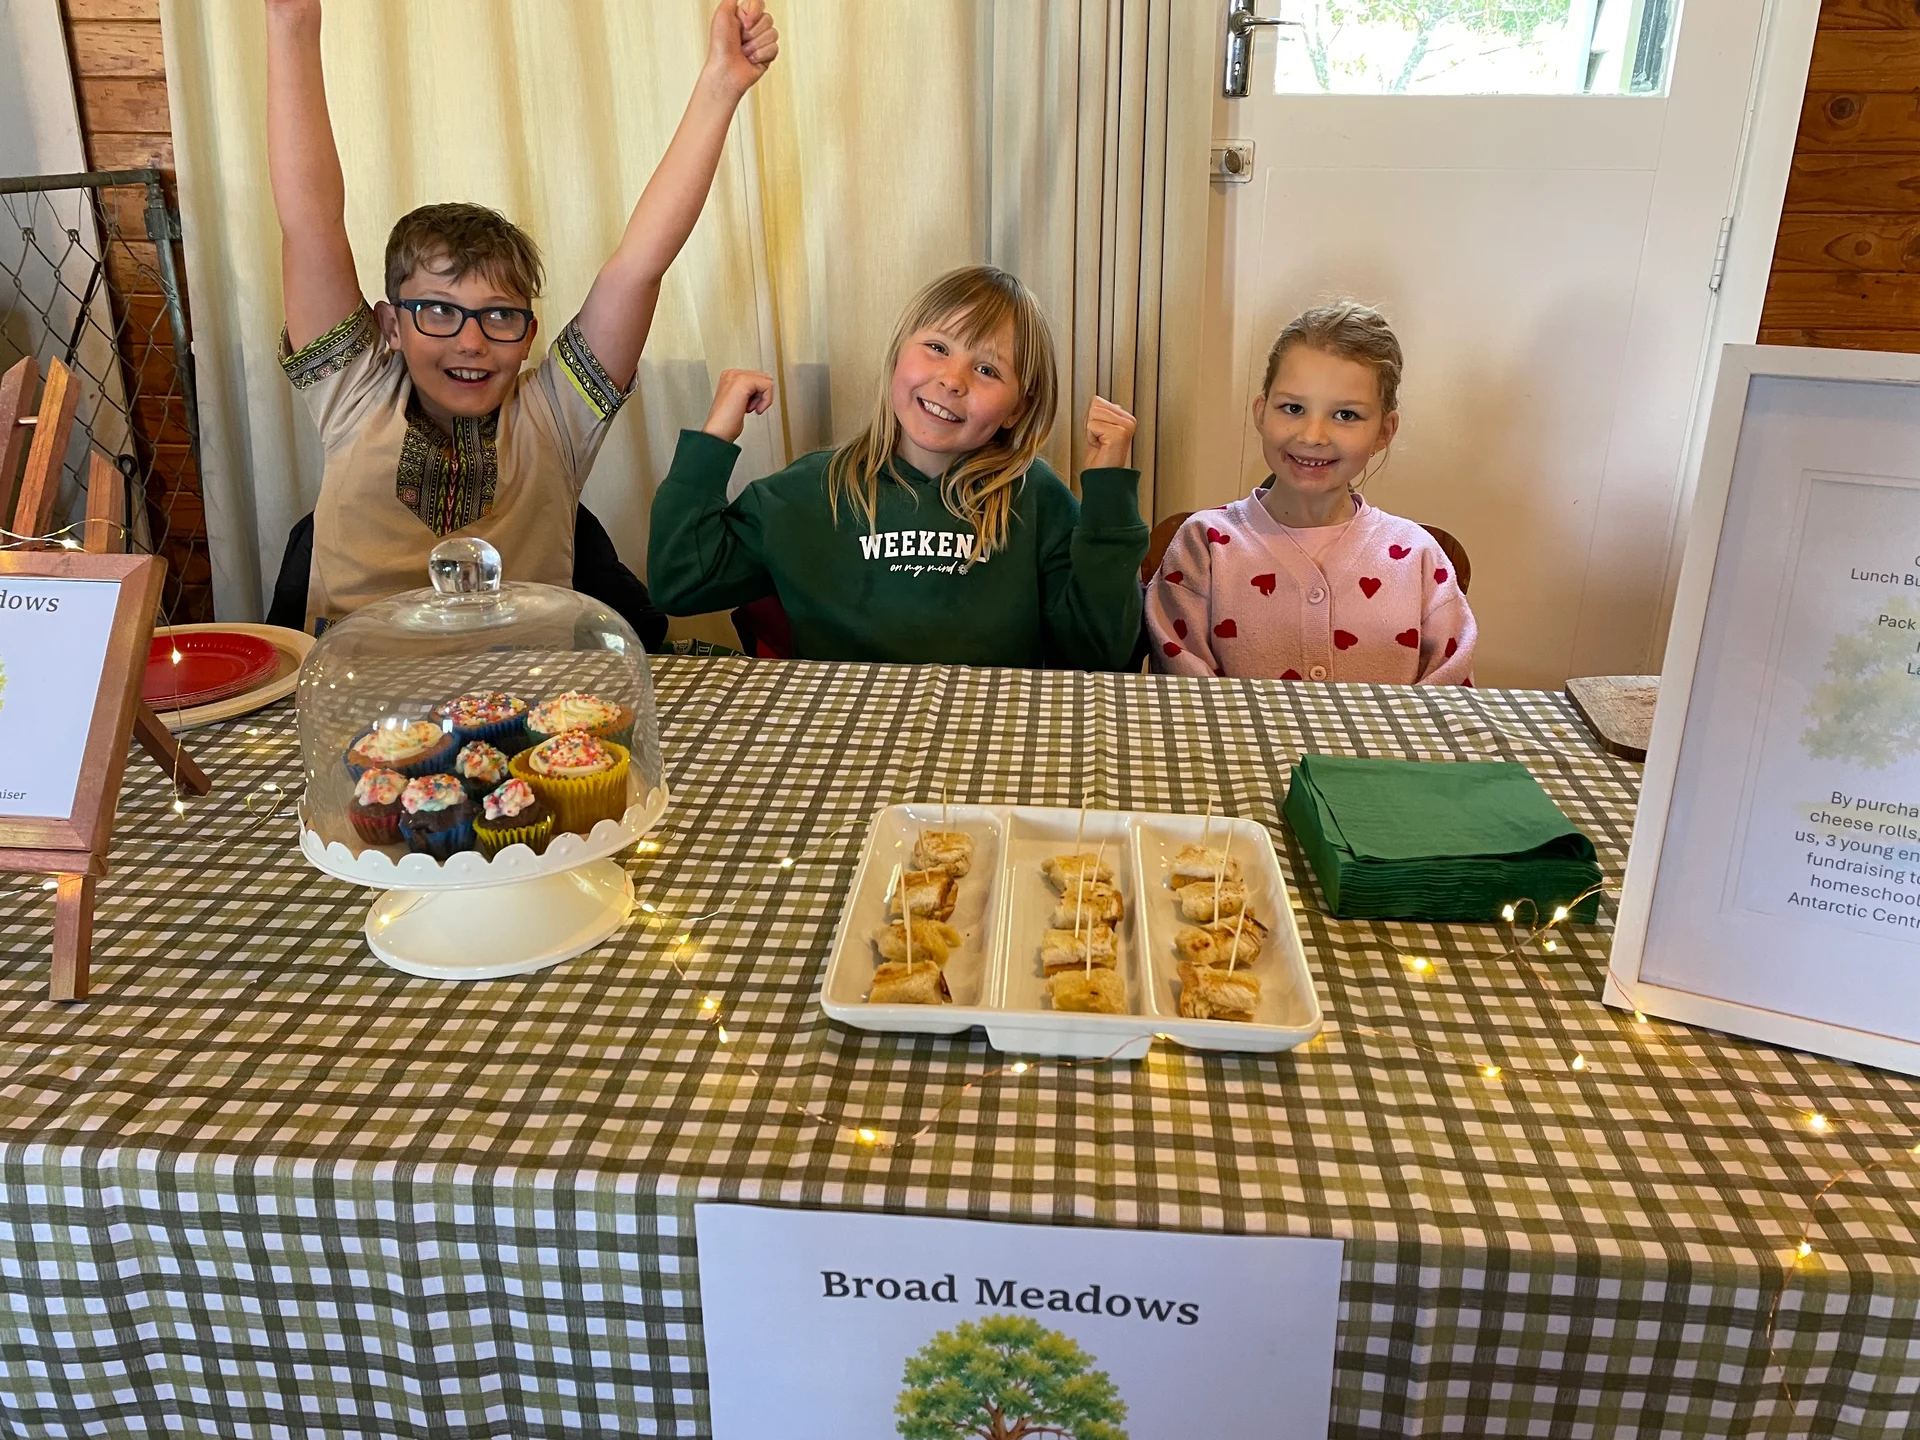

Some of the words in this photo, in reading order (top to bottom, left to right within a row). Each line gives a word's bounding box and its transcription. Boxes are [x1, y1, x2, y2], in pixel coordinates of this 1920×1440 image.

[859, 530, 991, 563] WEEKEN
[889, 563, 902, 572] on
[904, 563, 925, 577] my
[927, 561, 958, 574] mind
[1851, 567, 1899, 584] Lunch
[1878, 614, 1917, 631] Pack
[1831, 791, 1853, 809] By
[1856, 798, 1920, 818] purcha
[1810, 811, 1874, 832] cheese
[1795, 830, 1820, 846] us,
[1825, 834, 1837, 847] 3
[1840, 838, 1895, 860] young
[1806, 852, 1906, 884] fundraising
[1787, 892, 1868, 918] Antarctic
[820, 1271, 959, 1303] Broad
[975, 1277, 1200, 1326] Meadows
